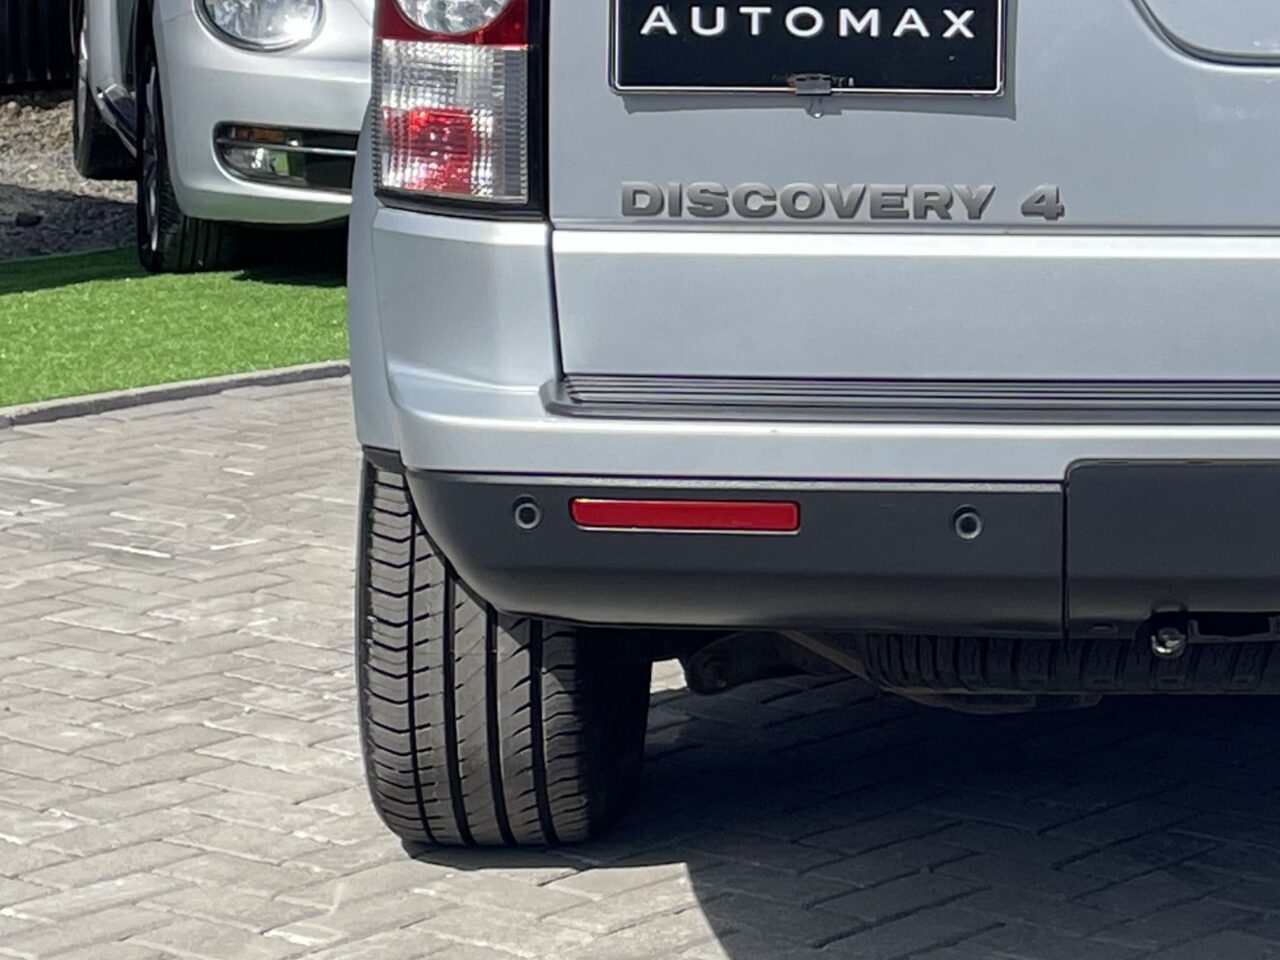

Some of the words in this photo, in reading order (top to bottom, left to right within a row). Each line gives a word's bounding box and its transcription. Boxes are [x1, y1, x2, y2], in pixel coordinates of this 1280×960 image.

[640, 5, 976, 38] AUTOMAX
[621, 181, 996, 221] DISCOVERY
[1021, 184, 1065, 221] 4
